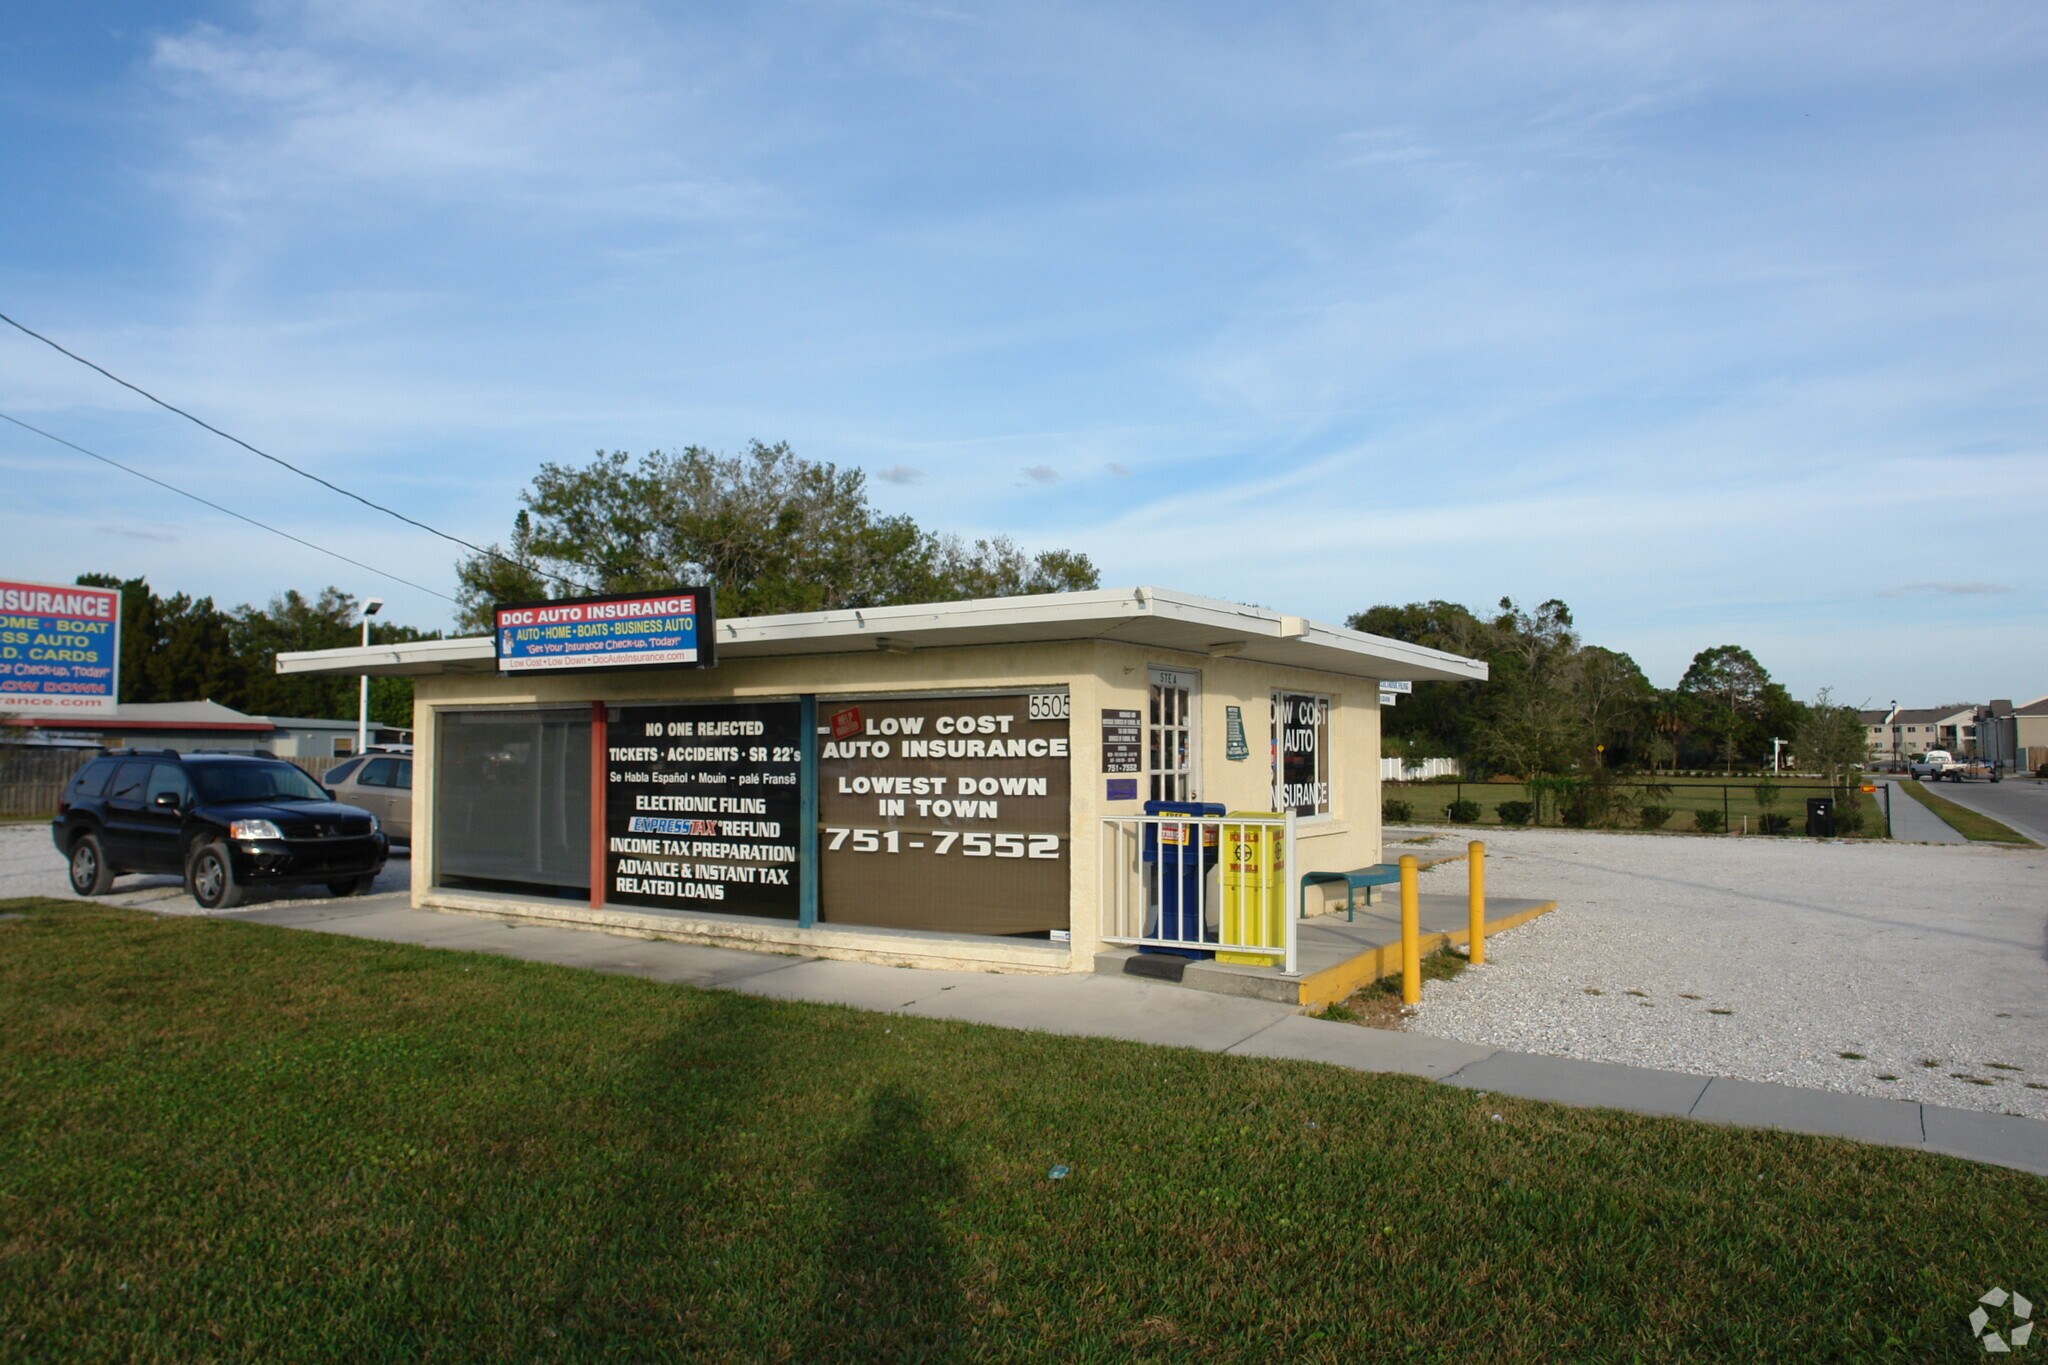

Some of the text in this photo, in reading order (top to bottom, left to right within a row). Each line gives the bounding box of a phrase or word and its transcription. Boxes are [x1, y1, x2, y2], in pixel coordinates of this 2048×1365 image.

[0, 589, 110, 617] SURANCE
[501, 599, 692, 625] DOC AUTO INSURANCE
[57, 620, 109, 634] BOAT
[516, 617, 693, 640] AUTO HOME BOATS BUSINESS AUTO
[0, 631, 89, 647] SS AUTO
[544, 643, 563, 653] Your
[564, 641, 604, 652] Insurance
[29, 648, 98, 662] CARDS
[509, 652, 684, 668] Low Cost Low Down DocAutoInsurance.com
[0, 680, 105, 694] OW DOWN
[1030, 695, 1070, 717] 5505
[645, 721, 764, 736] NO ONE REJECTED
[866, 715, 1013, 736] LOW COST
[822, 738, 1068, 758] AUTO INSURANCE
[1284, 729, 1314, 752] AUTO
[609, 747, 801, 762] TICKETS ACCIDENTS SR 22's
[609, 771, 622, 783] Se
[624, 771, 649, 783] Habla
[652, 772, 688, 785] Español
[698, 772, 727, 783] Mouin
[739, 773, 759, 786] palé
[839, 777, 1047, 796] LOWEST DOWN
[636, 795, 766, 814] ELECTRONIC FILING
[879, 799, 998, 819] IN TOWN
[722, 821, 781, 838] REFUND
[610, 837, 795, 862] INCOME TAX PREPARATION
[825, 828, 1060, 859] 751-7552
[617, 859, 789, 885] ADVANCE & INSTANT TAX
[616, 877, 724, 900] RELATED LOANS
